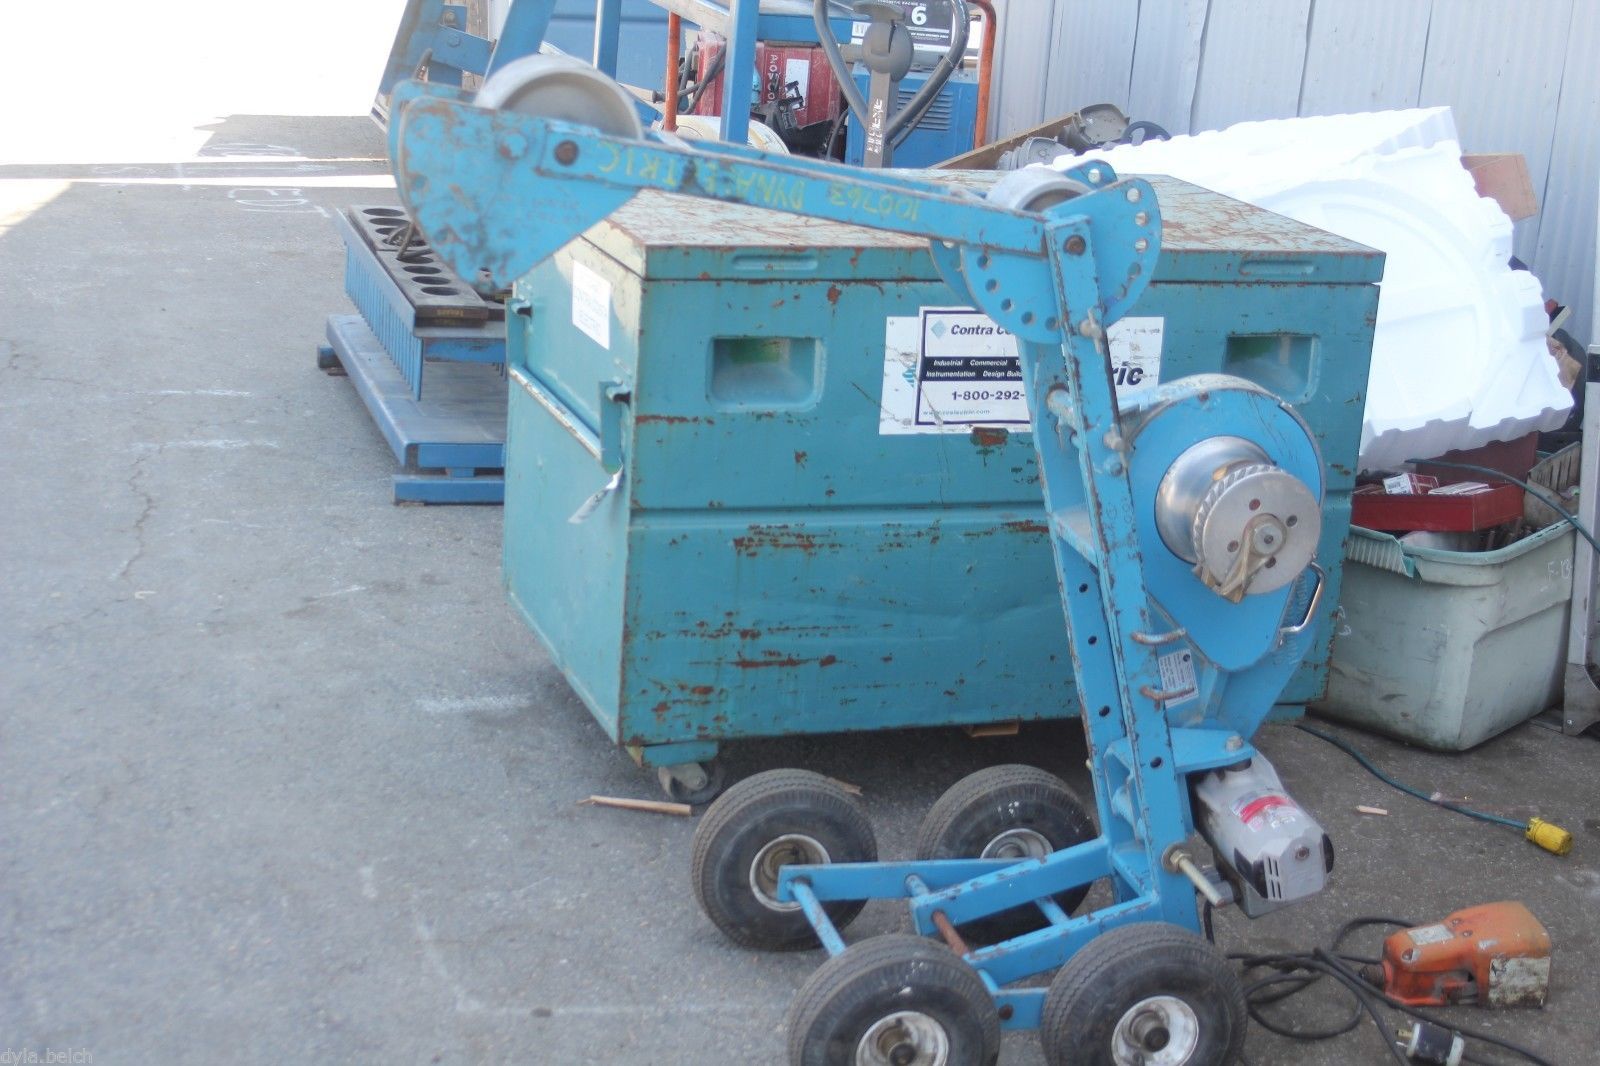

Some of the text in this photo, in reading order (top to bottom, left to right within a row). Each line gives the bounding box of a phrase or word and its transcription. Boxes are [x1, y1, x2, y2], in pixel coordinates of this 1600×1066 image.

[911, 5, 928, 26] 6
[950, 324, 993, 337] Contra
[933, 358, 964, 367] Industrial
[969, 358, 1009, 367] Commercial
[925, 369, 977, 378] Instrumentation
[982, 370, 1006, 379] Design
